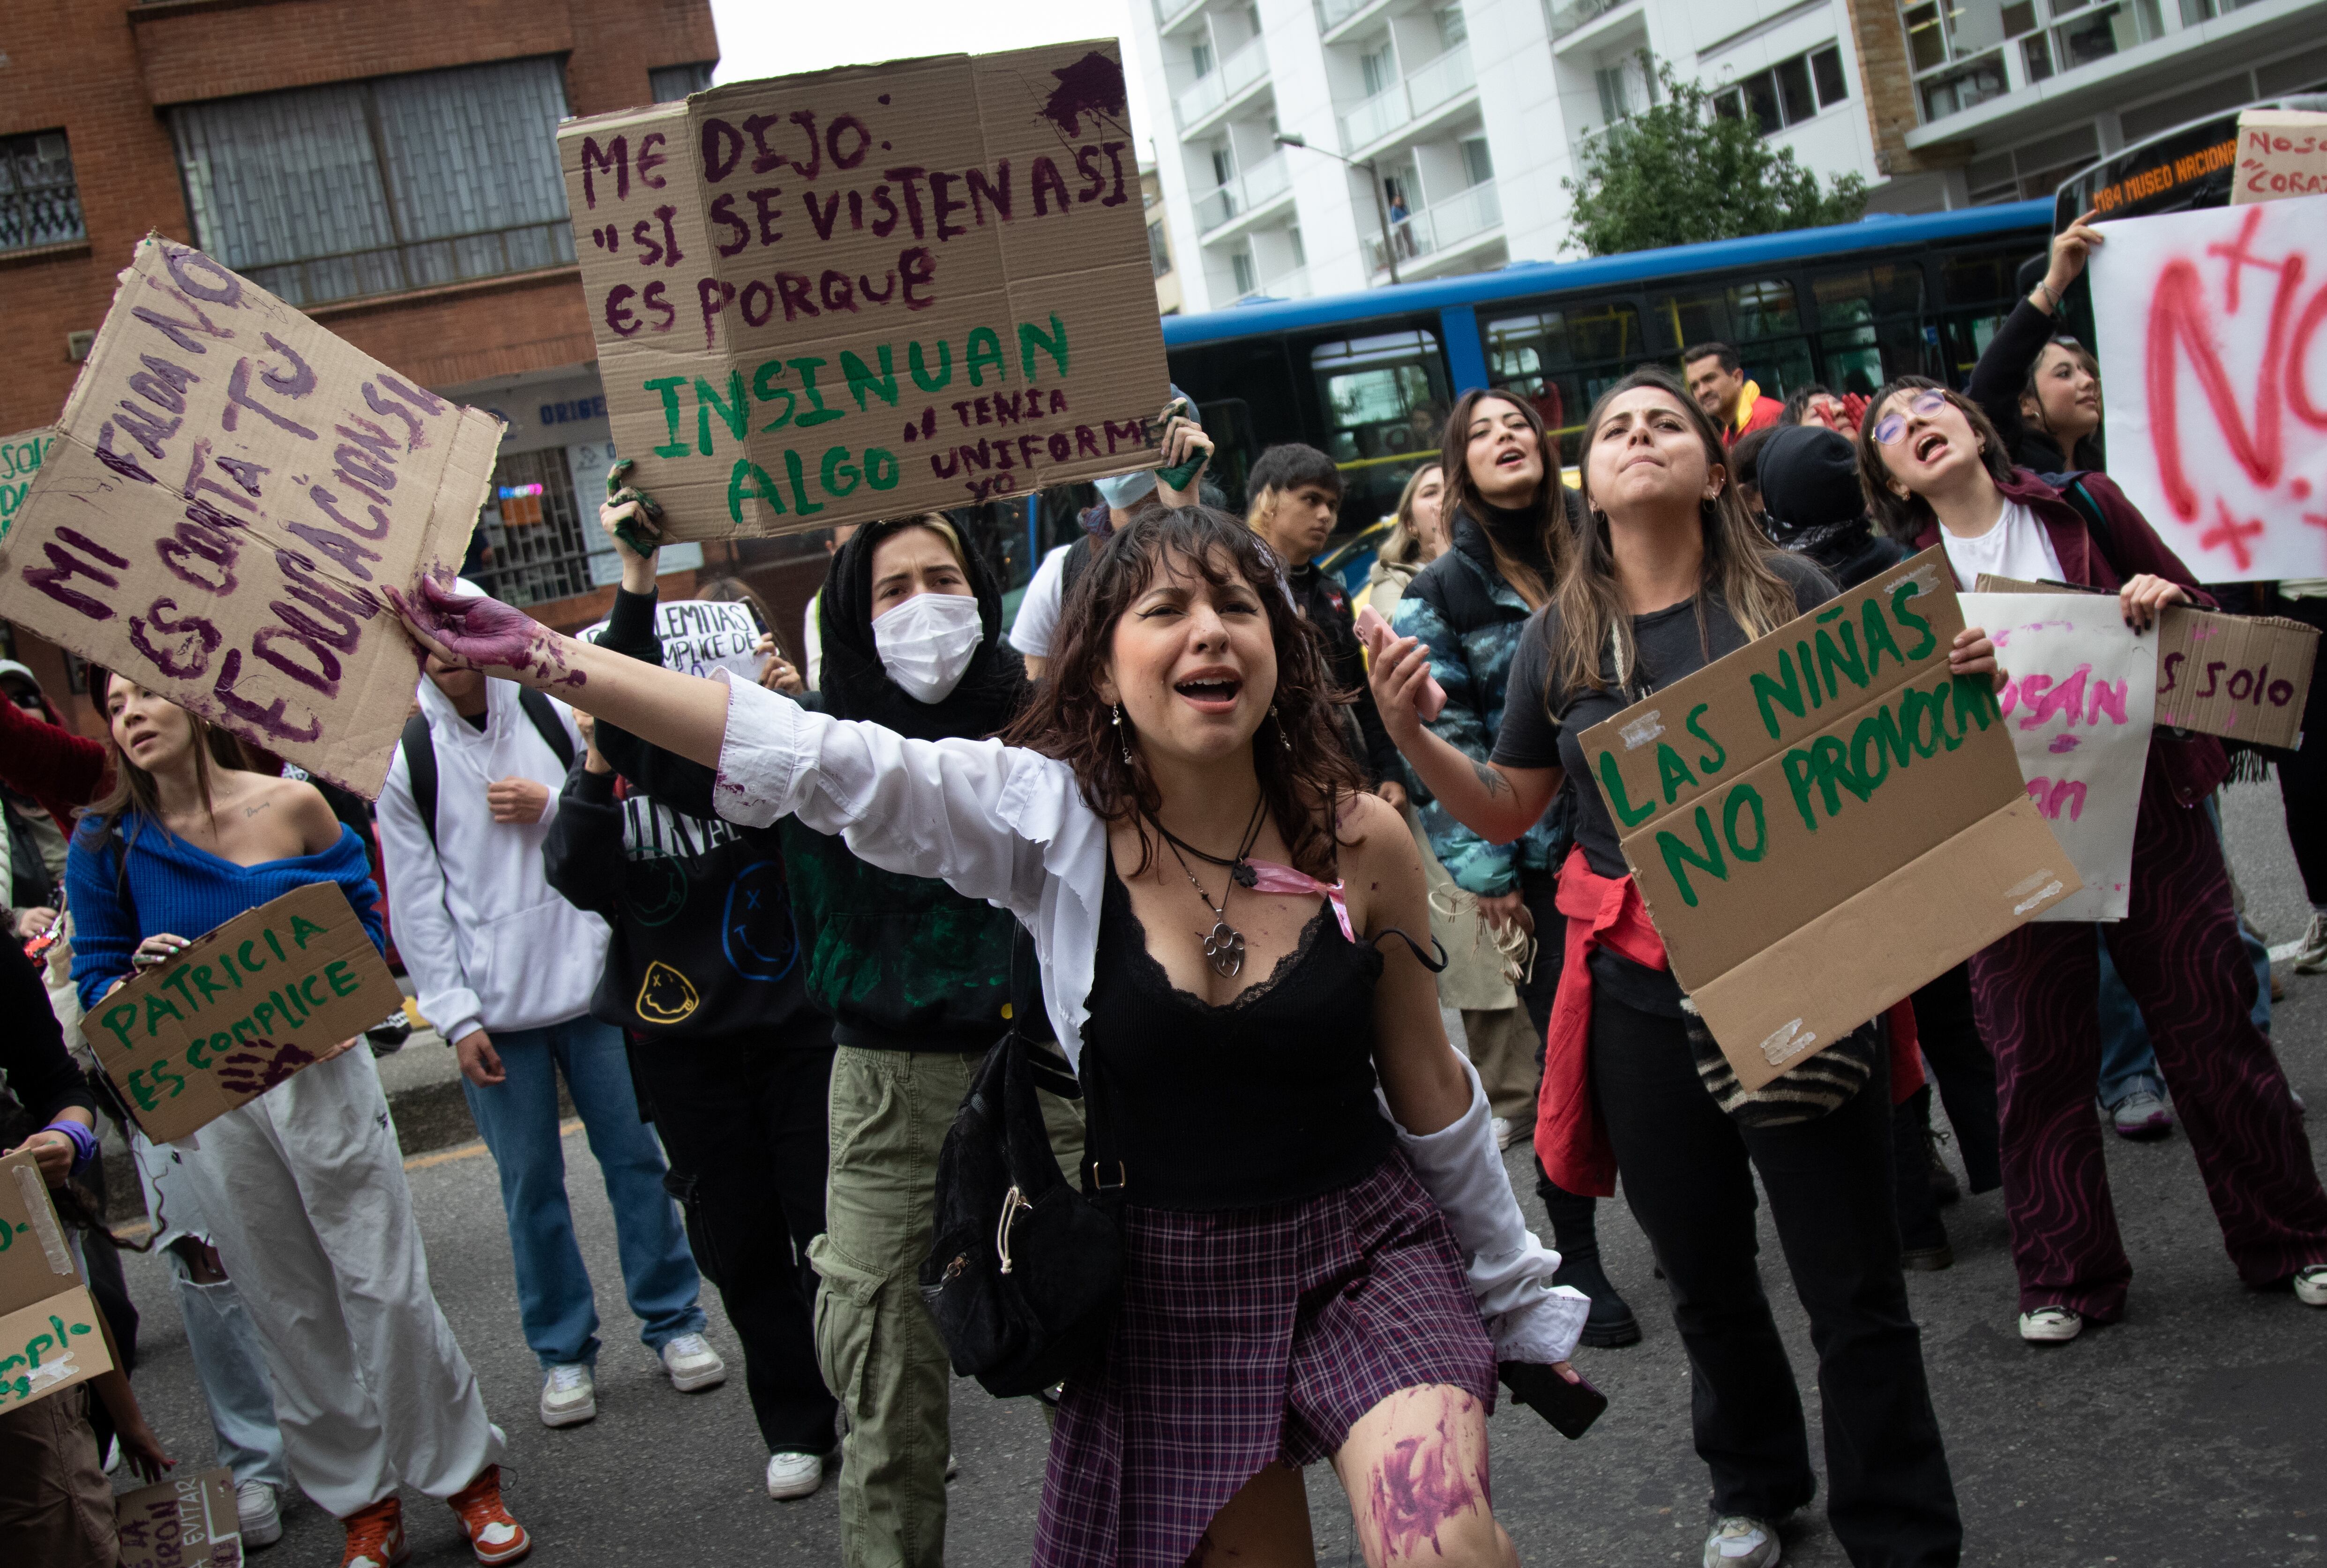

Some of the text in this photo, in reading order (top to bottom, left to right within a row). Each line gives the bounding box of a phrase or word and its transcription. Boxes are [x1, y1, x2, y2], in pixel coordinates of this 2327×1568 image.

[582, 132, 668, 210] ME
[711, 187, 783, 257] SE
[802, 157, 1013, 241] VISTEN
[1031, 141, 1129, 216] ASI
[2093, 183, 2124, 214] M84
[2124, 164, 2174, 202] MUSEO
[605, 246, 937, 353] ES PORQUE
[22, 246, 253, 620] MI FALDA NO
[643, 310, 1070, 459] INSINUAN
[951, 388, 1069, 428] TENIA
[965, 471, 1017, 503] YO
[129, 597, 223, 680] ES
[1597, 581, 1937, 828] LAS NIÑAS
[1655, 784, 1769, 908] NO
[101, 915, 329, 1050] PATRICIA
[128, 960, 361, 1111] ES COMPLICE
[174, 1478, 206, 1546] EVITAR
